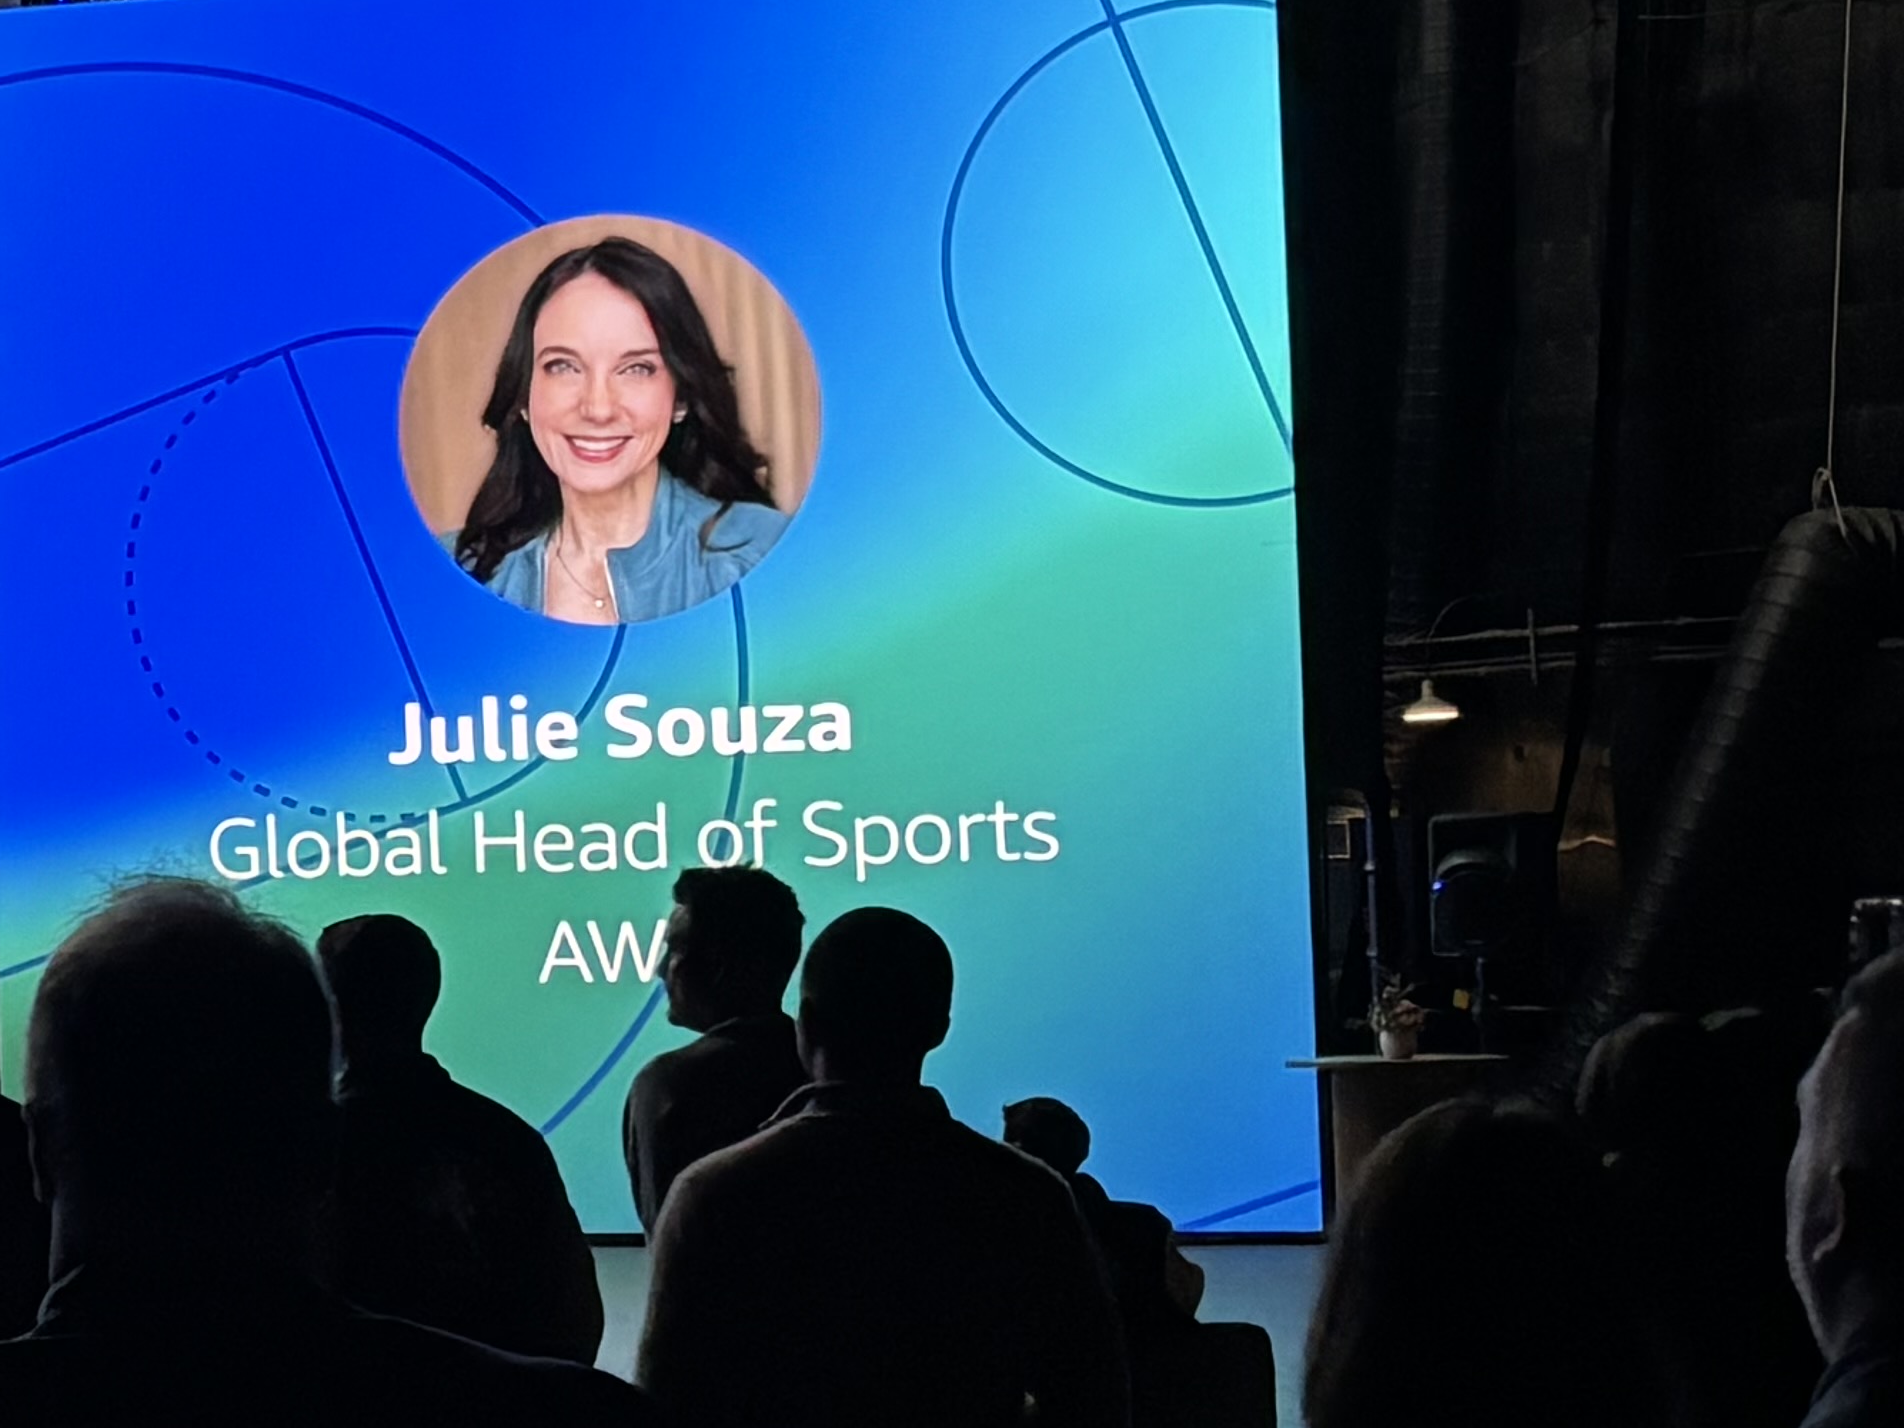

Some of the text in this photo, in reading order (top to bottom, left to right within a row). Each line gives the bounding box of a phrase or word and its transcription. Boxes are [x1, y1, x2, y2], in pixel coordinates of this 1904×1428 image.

[388, 693, 852, 765] Julie Souza
[210, 798, 1059, 882] Global Head of Sports
[539, 919, 667, 983] AW
